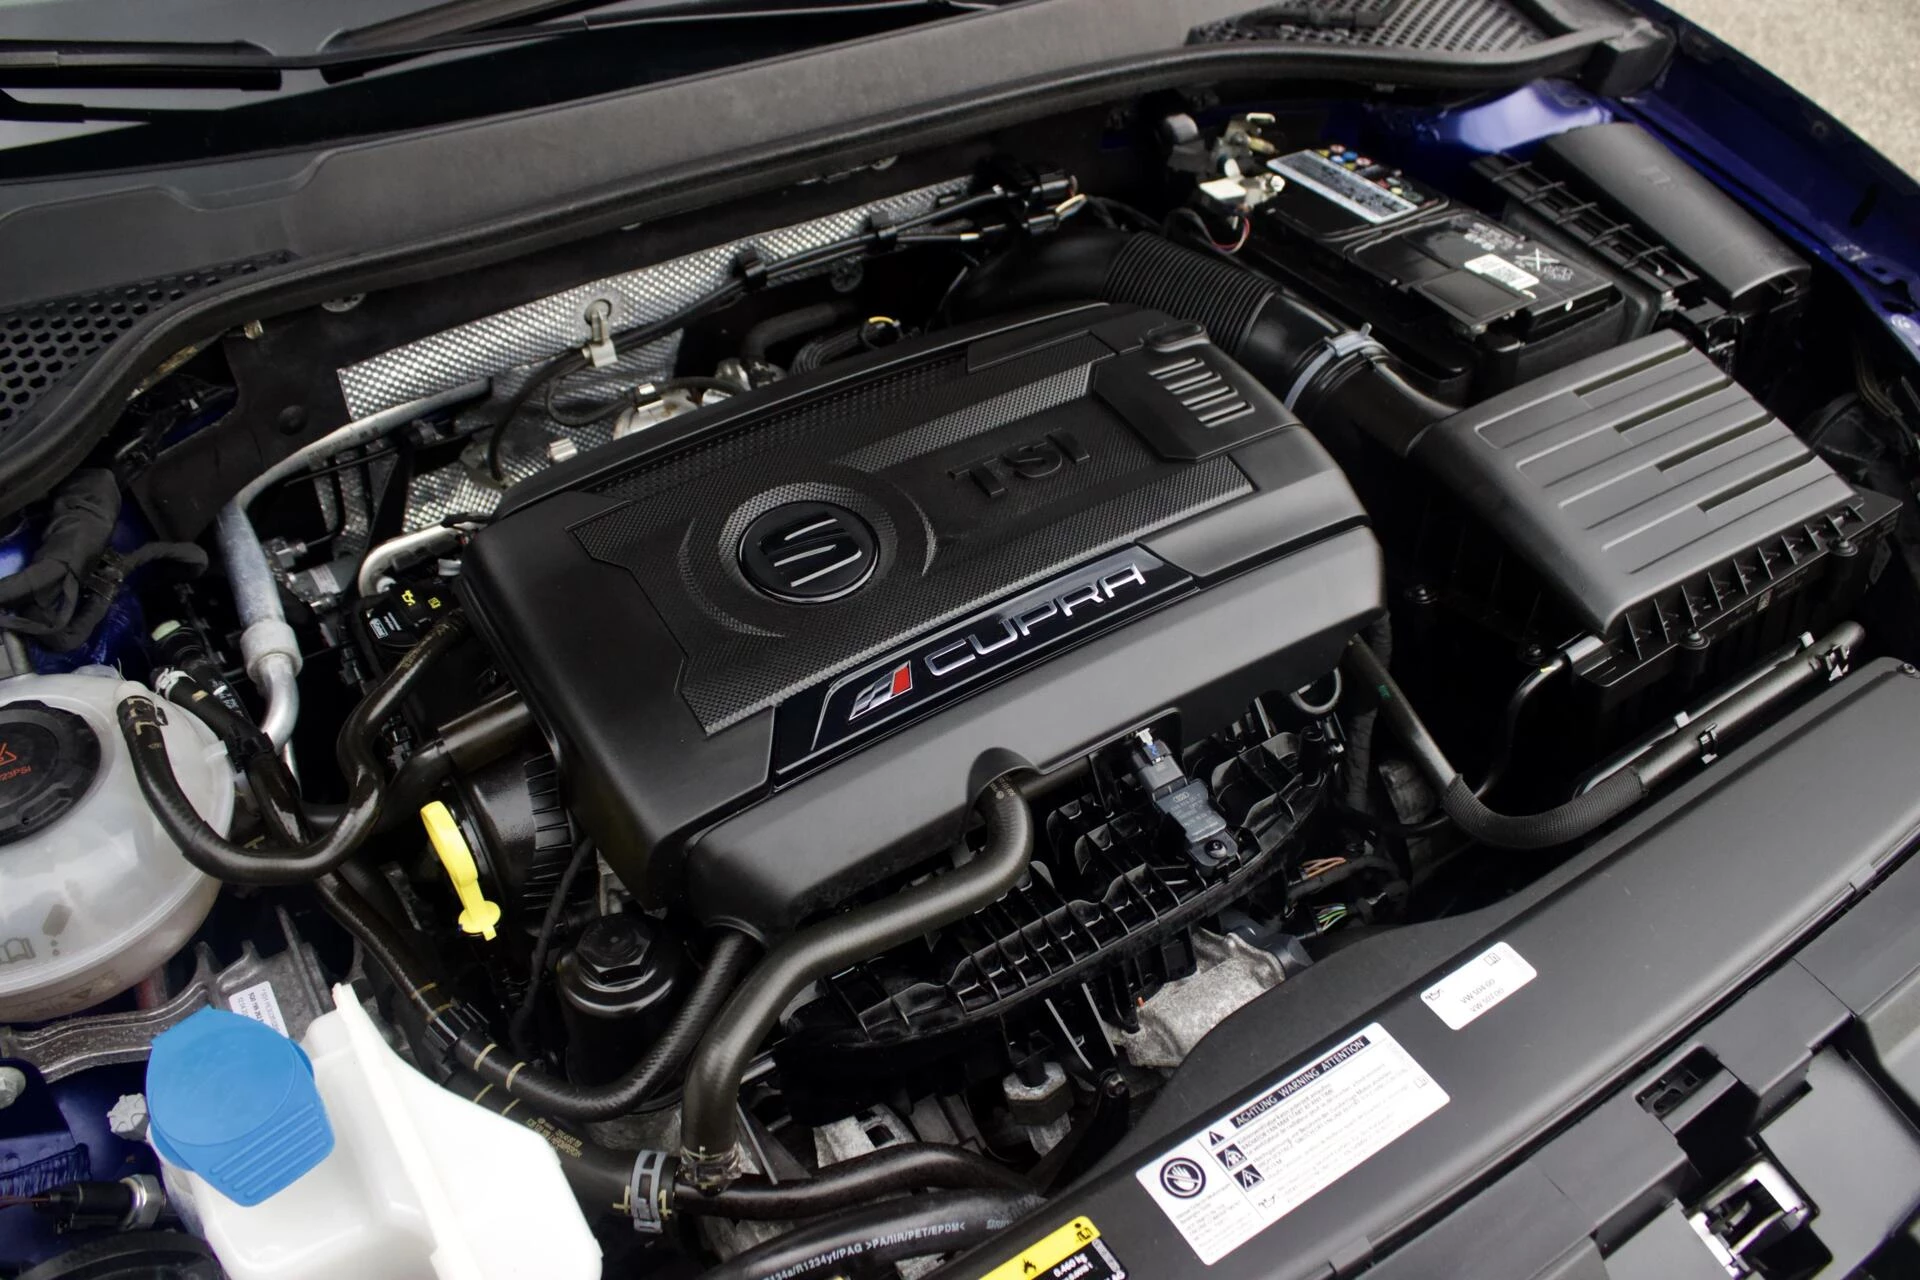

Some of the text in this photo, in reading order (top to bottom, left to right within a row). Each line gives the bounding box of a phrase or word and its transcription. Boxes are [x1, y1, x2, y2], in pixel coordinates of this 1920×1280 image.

[946, 427, 1091, 498] TSI
[924, 561, 1146, 677] CUPRA
[1235, 1038, 1366, 1126] ACHTUNG WARNING ATTENTION
